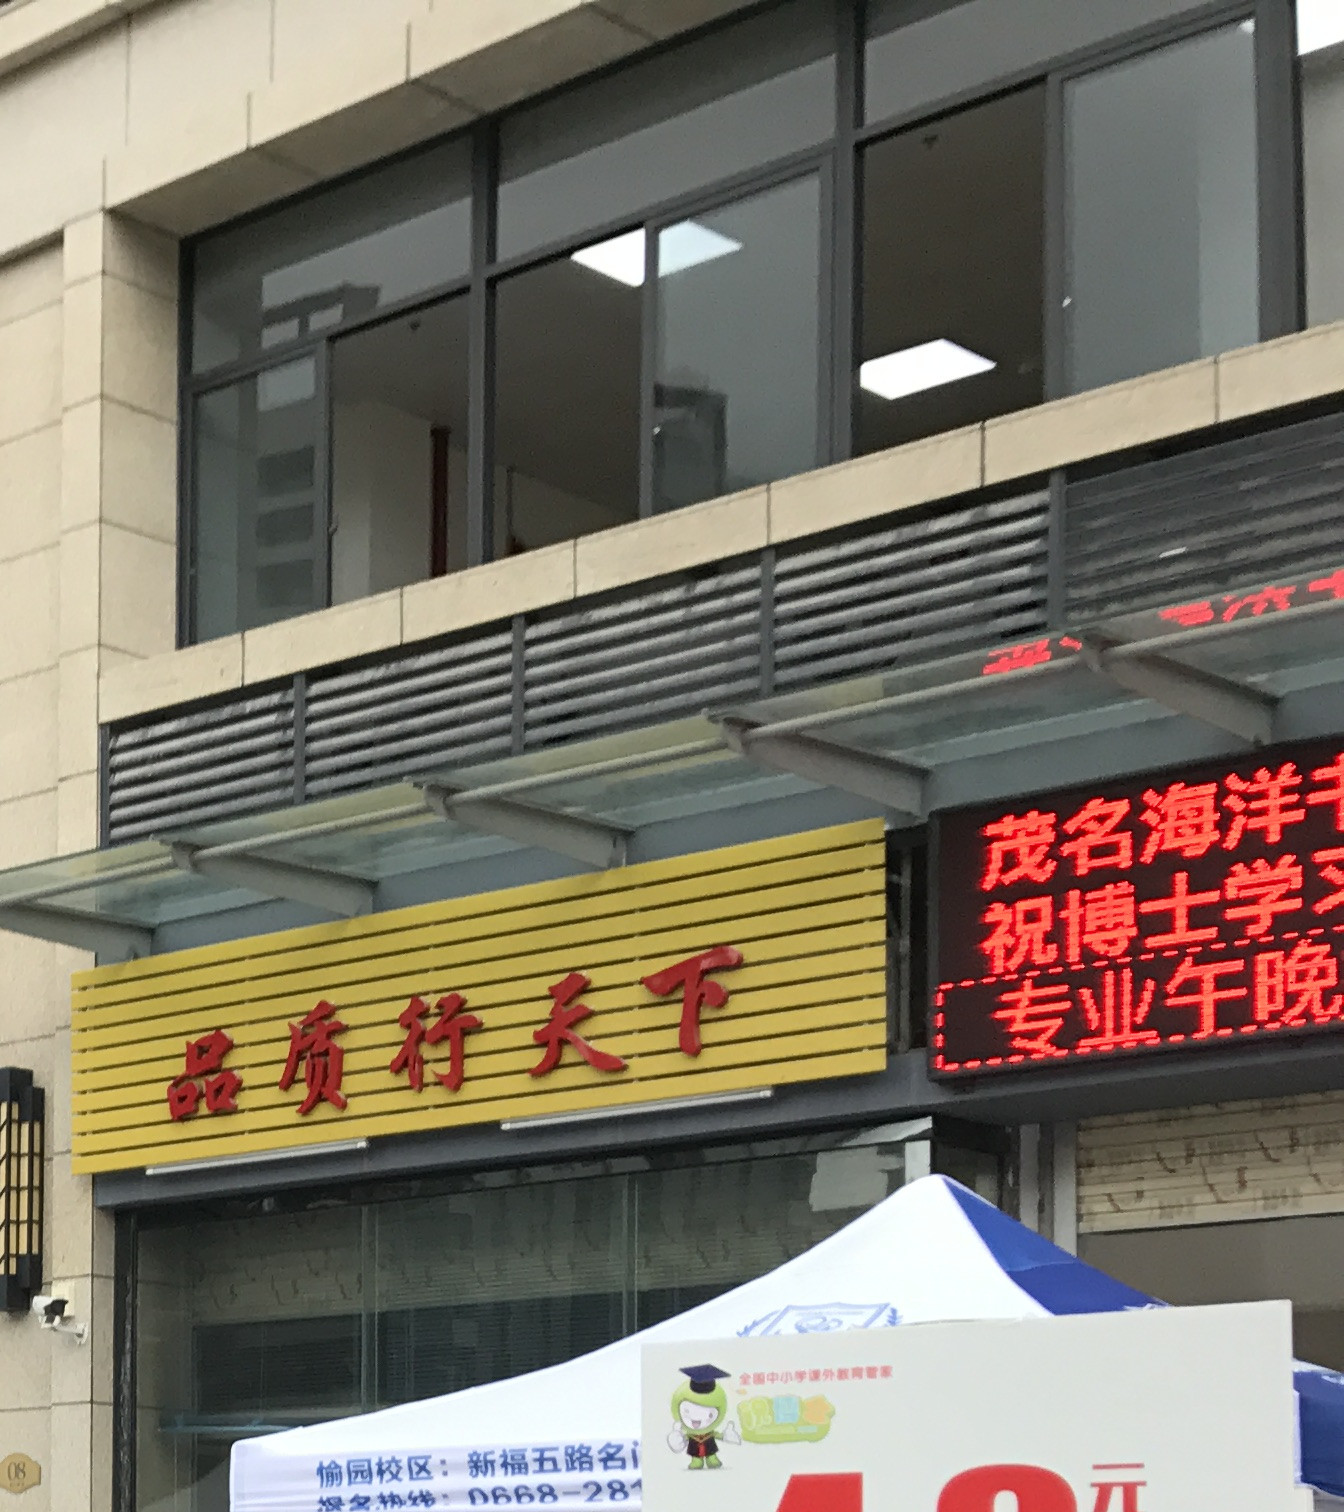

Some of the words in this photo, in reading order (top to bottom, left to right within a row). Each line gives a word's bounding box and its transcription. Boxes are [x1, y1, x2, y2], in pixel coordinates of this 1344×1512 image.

[166, 944, 744, 1122] 品质行天下
